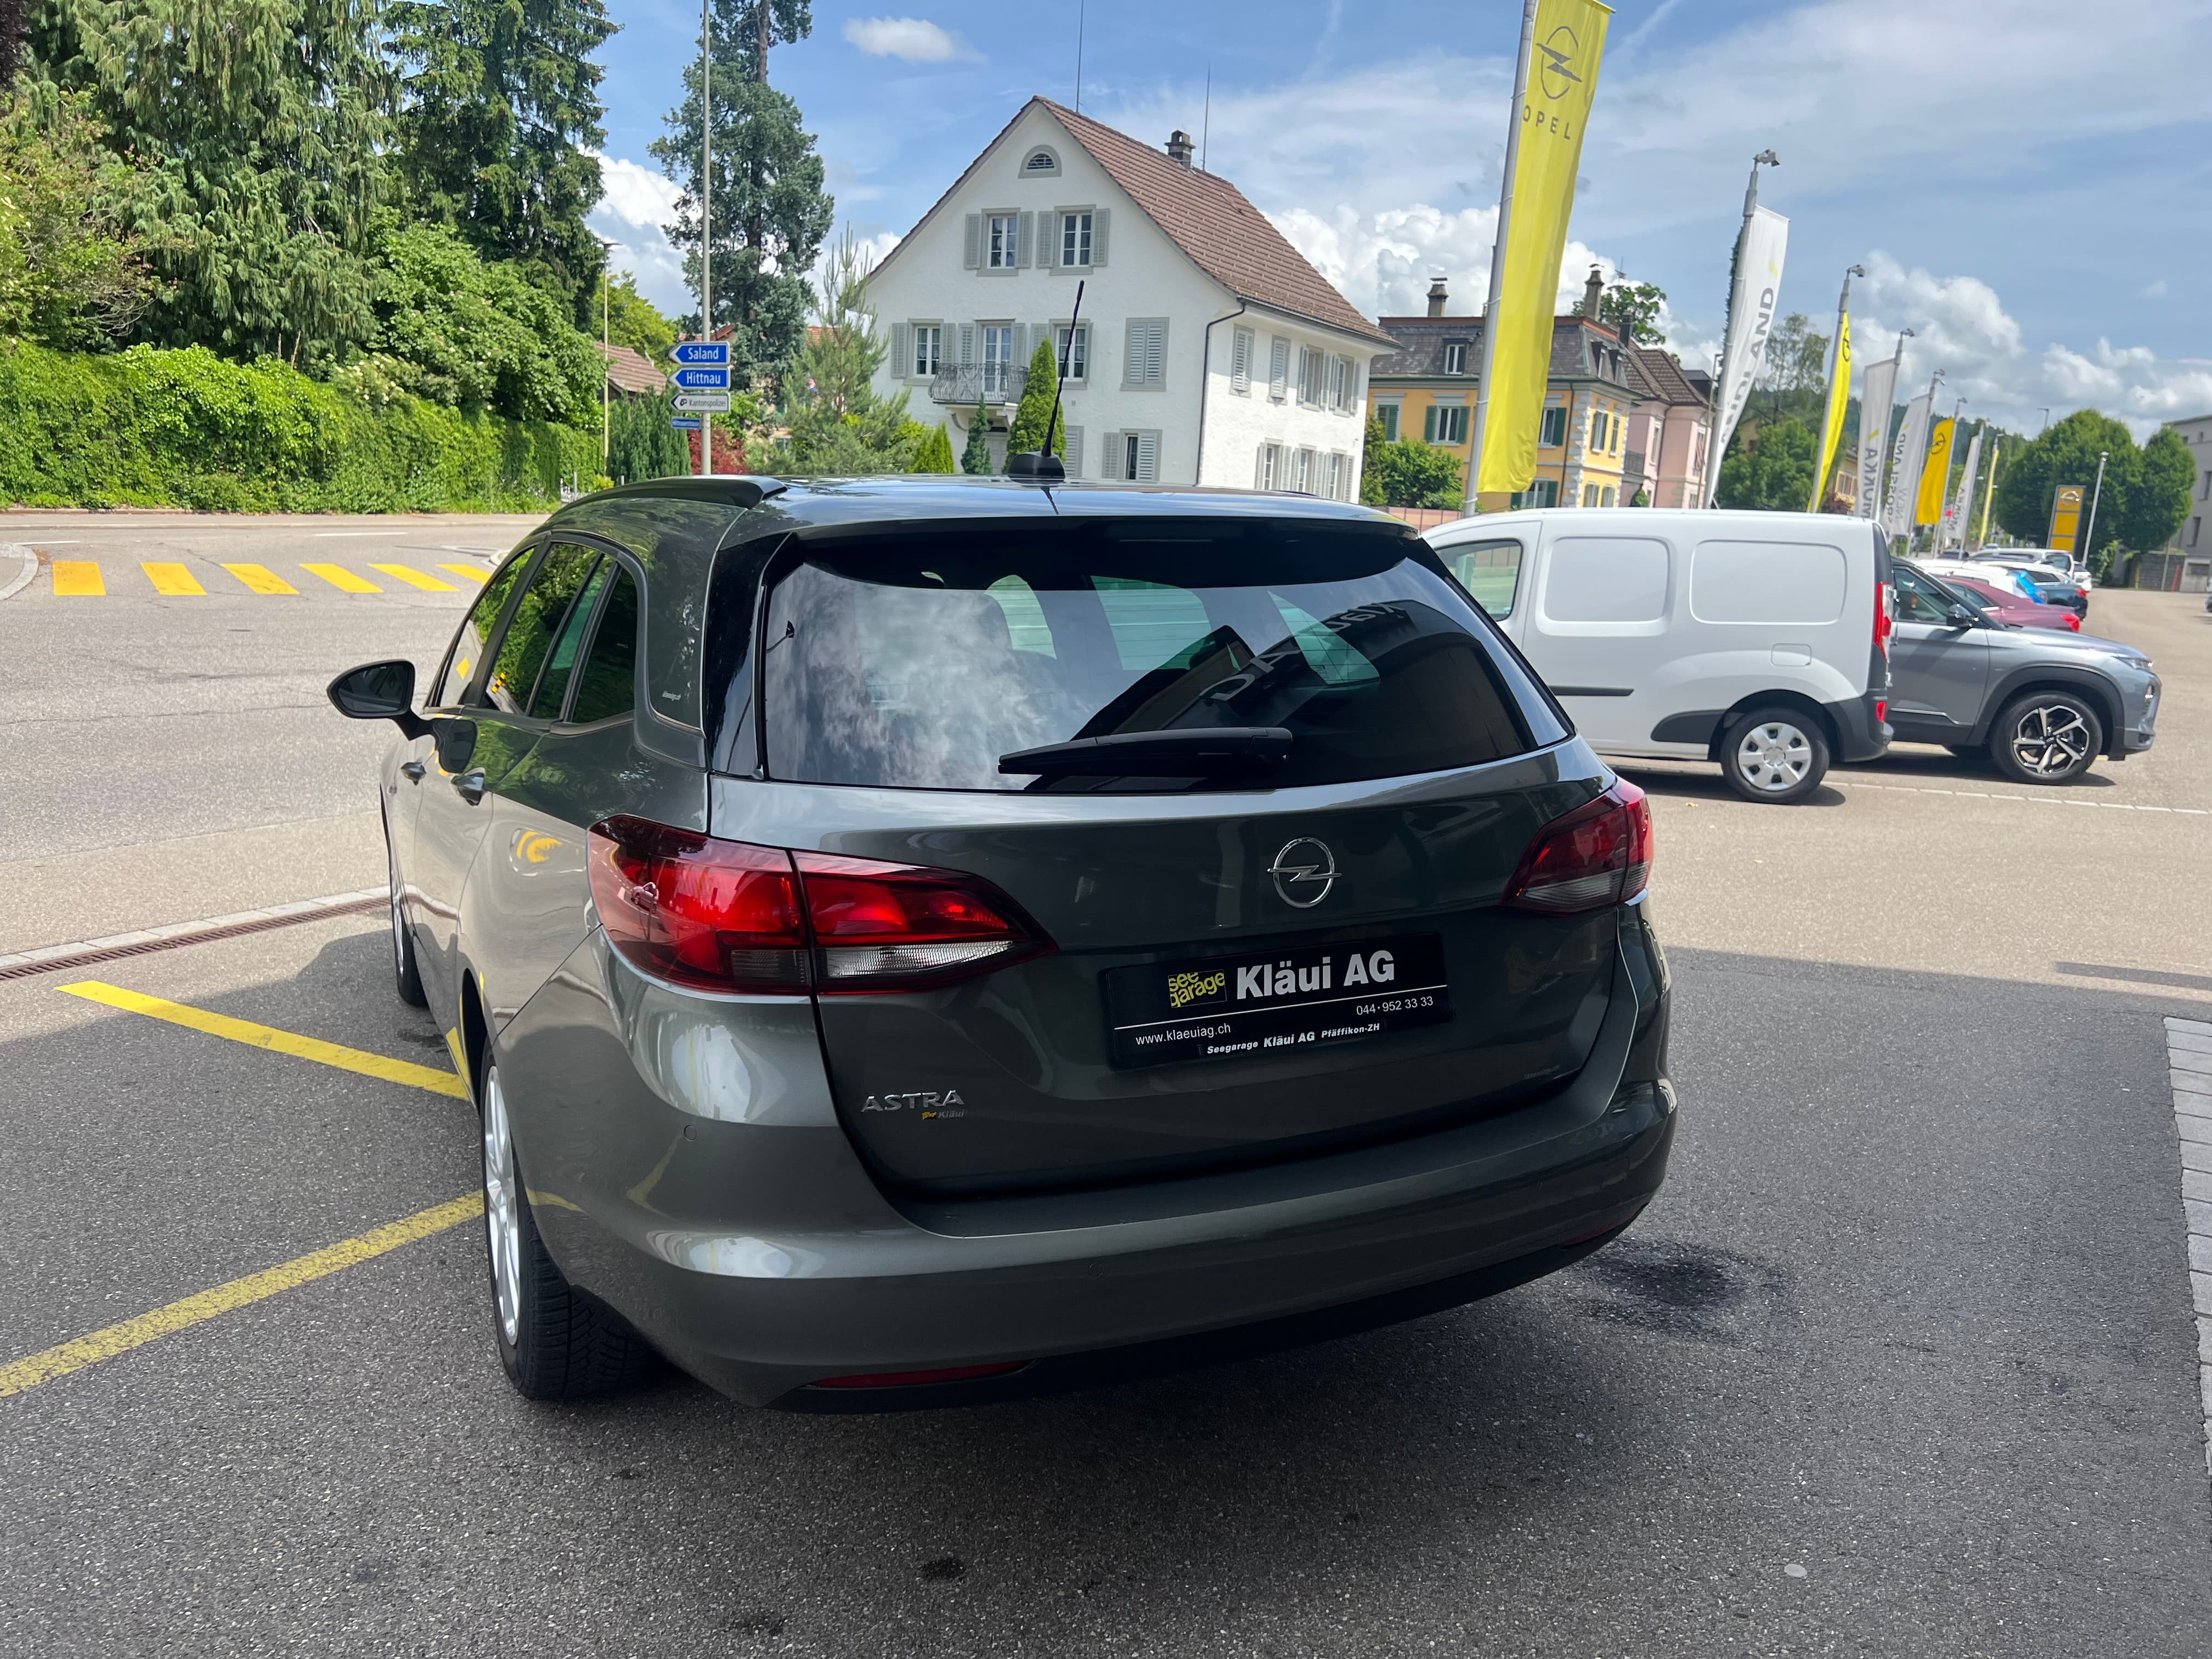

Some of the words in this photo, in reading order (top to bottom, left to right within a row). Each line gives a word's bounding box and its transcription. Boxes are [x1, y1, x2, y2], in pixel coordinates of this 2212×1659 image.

[1522, 105, 1571, 140] OPEL
[688, 347, 719, 360] Saland
[686, 371, 721, 384] Hittnau
[689, 399, 726, 408] Kantonspolizei
[1169, 972, 1199, 992] see
[1237, 956, 1331, 1000] Kläui
[1343, 950, 1395, 987] AG
[1170, 973, 1225, 1008] garage
[1404, 998, 1418, 1009] 33
[1420, 996, 1434, 1006] 33
[1136, 1023, 1231, 1045] www.klaeuiag.ch
[1207, 1041, 1259, 1054] Seegarage
[1263, 1034, 1295, 1047] Kläui
[1297, 1031, 1316, 1042] AG
[1321, 1023, 1380, 1038] Pfäffikon-ZH
[861, 1090, 964, 1113] ASTRA
